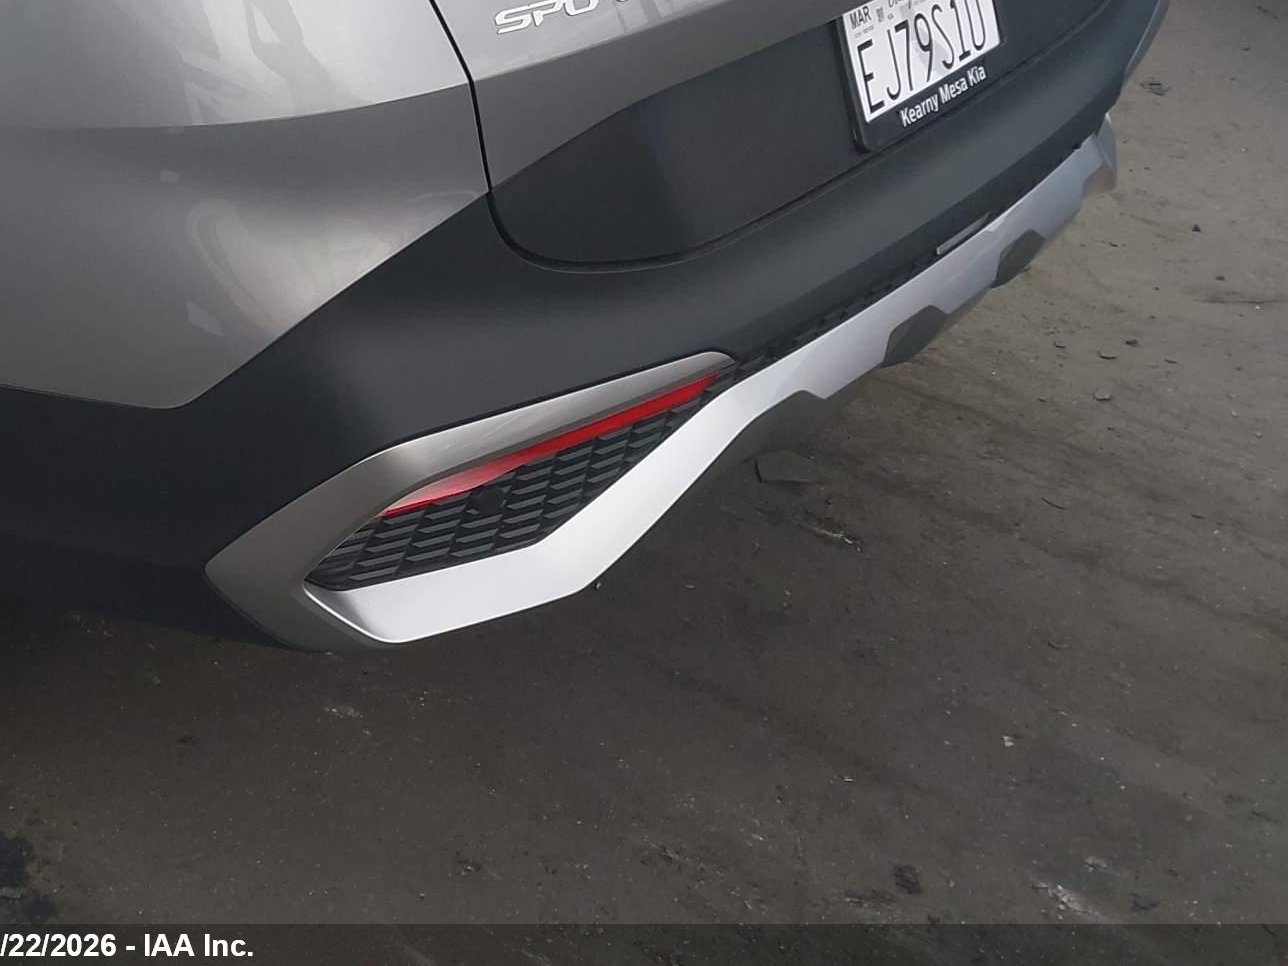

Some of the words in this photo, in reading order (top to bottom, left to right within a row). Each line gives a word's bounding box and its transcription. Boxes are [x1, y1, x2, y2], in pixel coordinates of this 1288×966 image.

[850, 6, 872, 30] MAR
[900, 95, 939, 127] Kearny
[939, 79, 968, 104] Mesa
[969, 65, 987, 85] Kia
